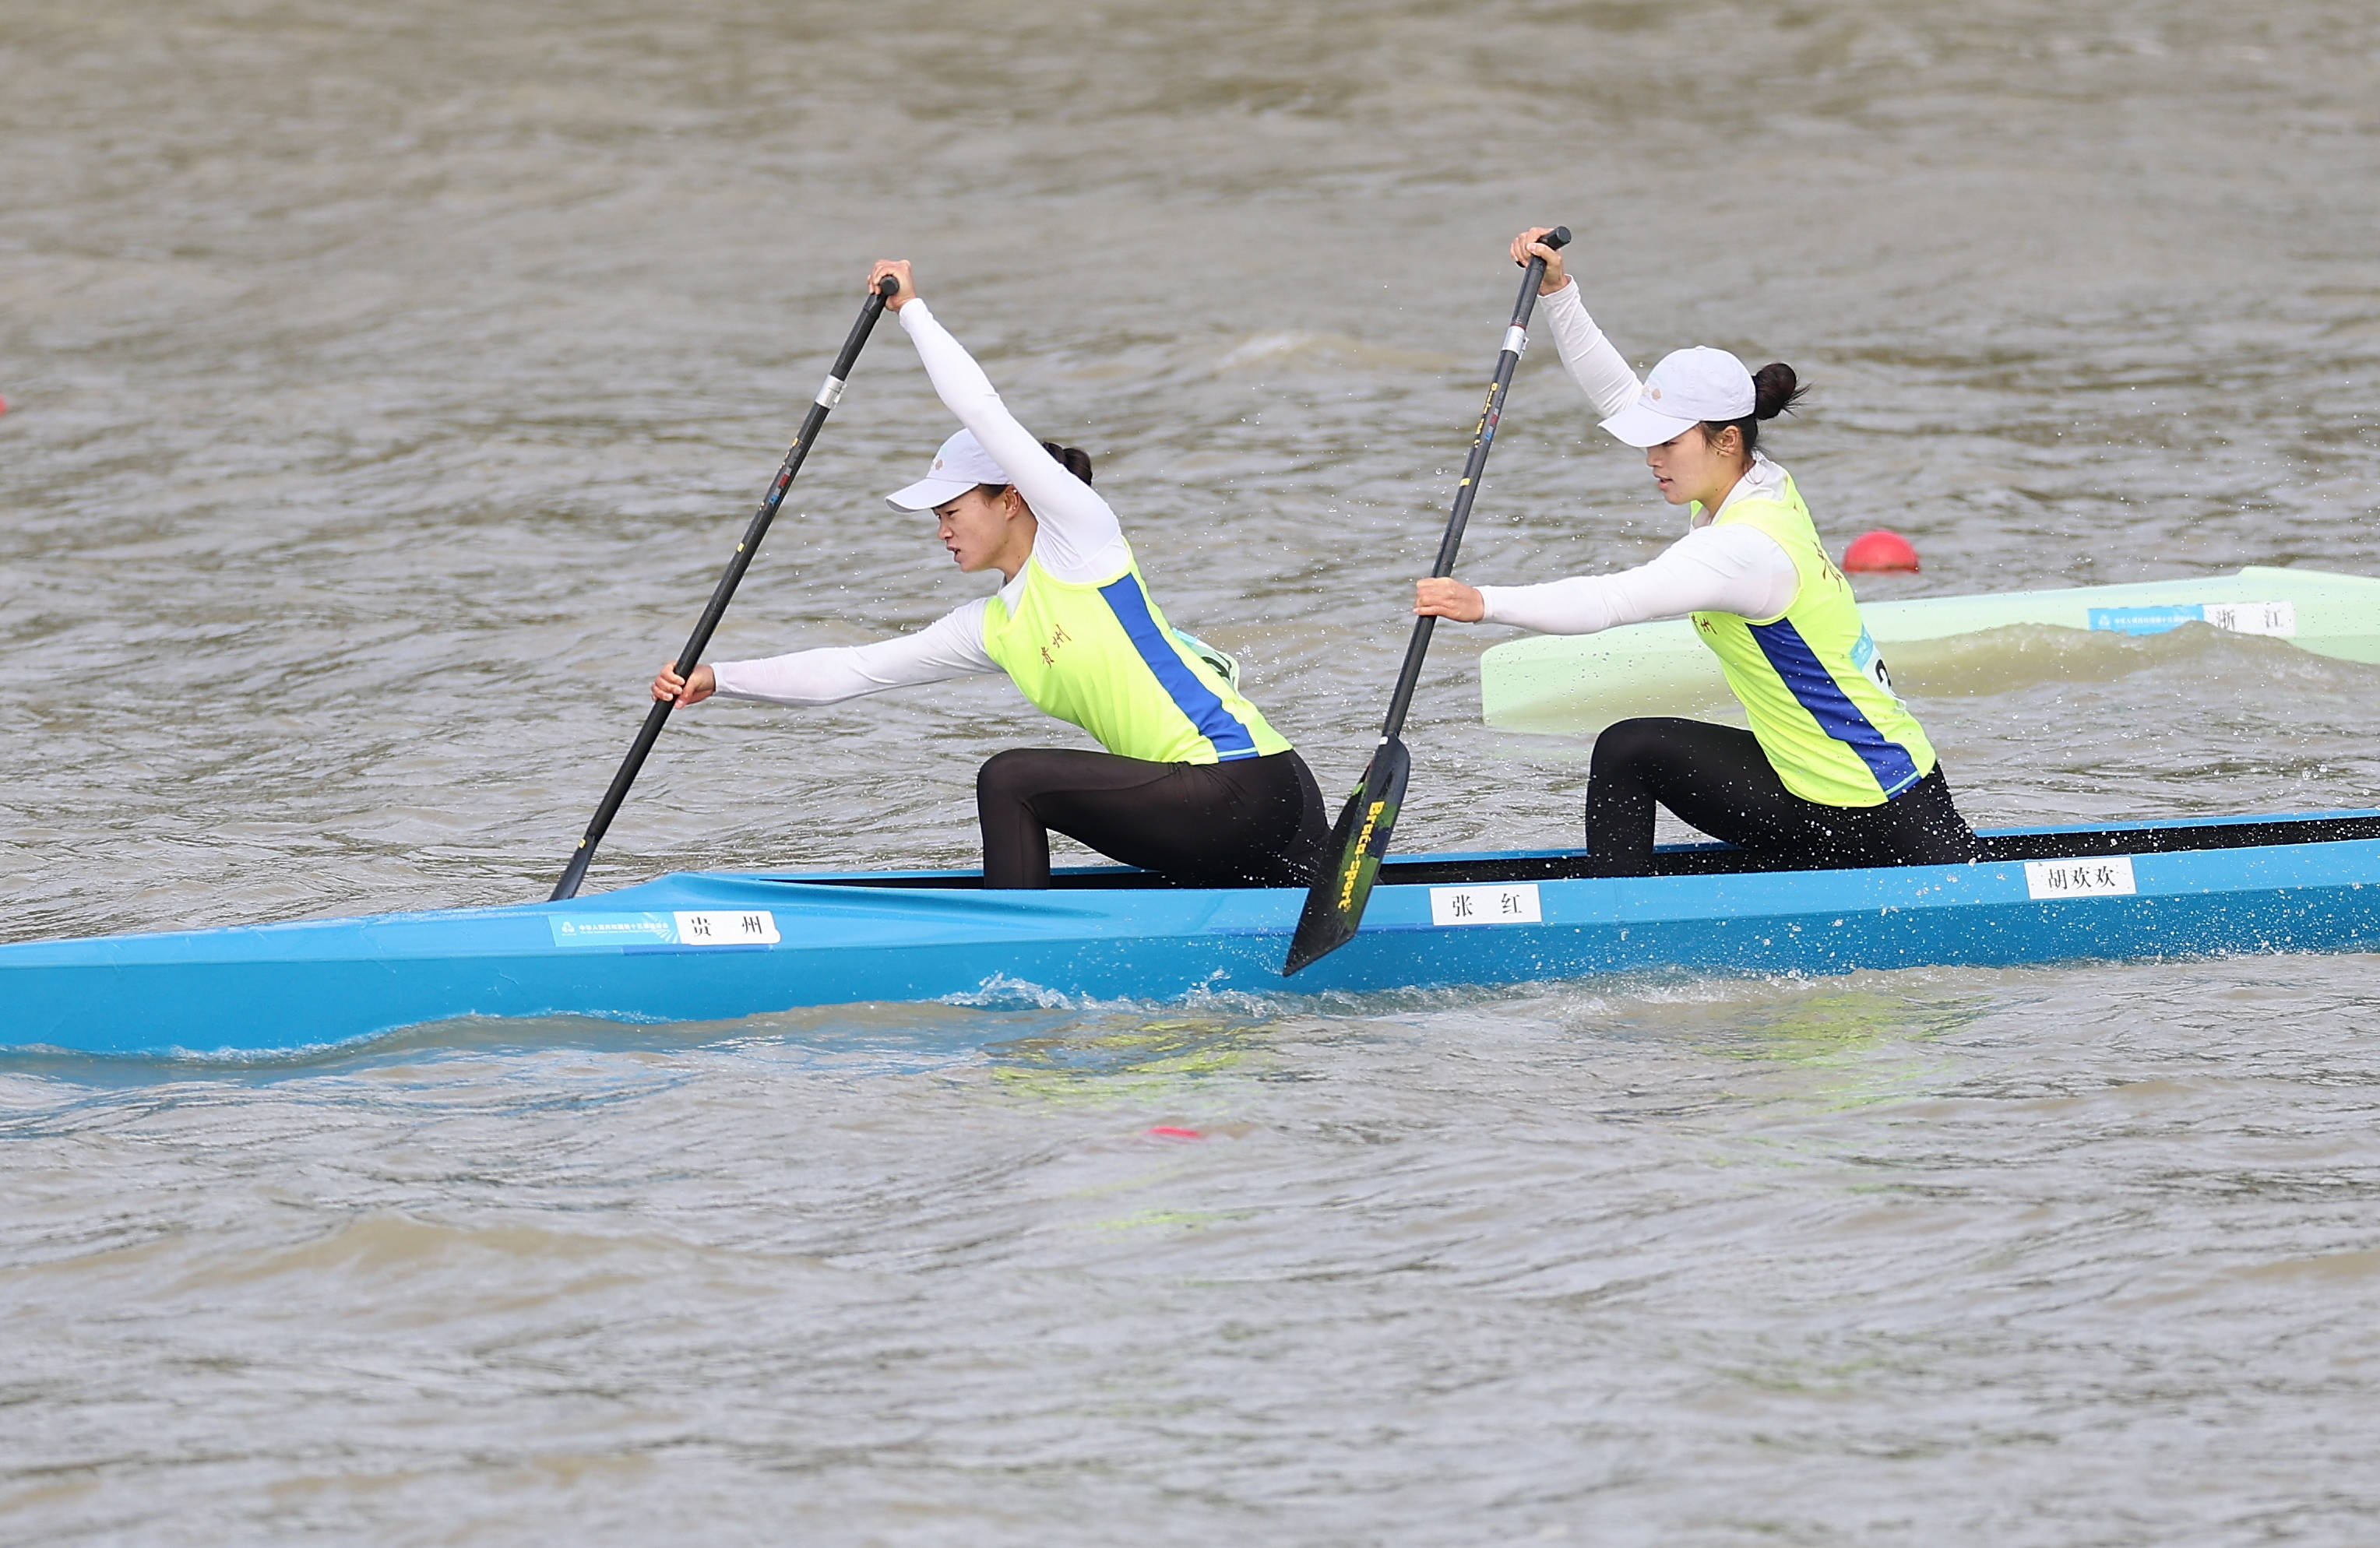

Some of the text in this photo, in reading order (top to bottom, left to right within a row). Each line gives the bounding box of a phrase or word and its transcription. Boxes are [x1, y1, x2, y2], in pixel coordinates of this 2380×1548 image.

[2216, 609, 2283, 629] 浙江
[2048, 866, 2116, 890] 胡欢欢
[1452, 892, 1523, 917] 张红
[691, 916, 763, 936] 贵州
